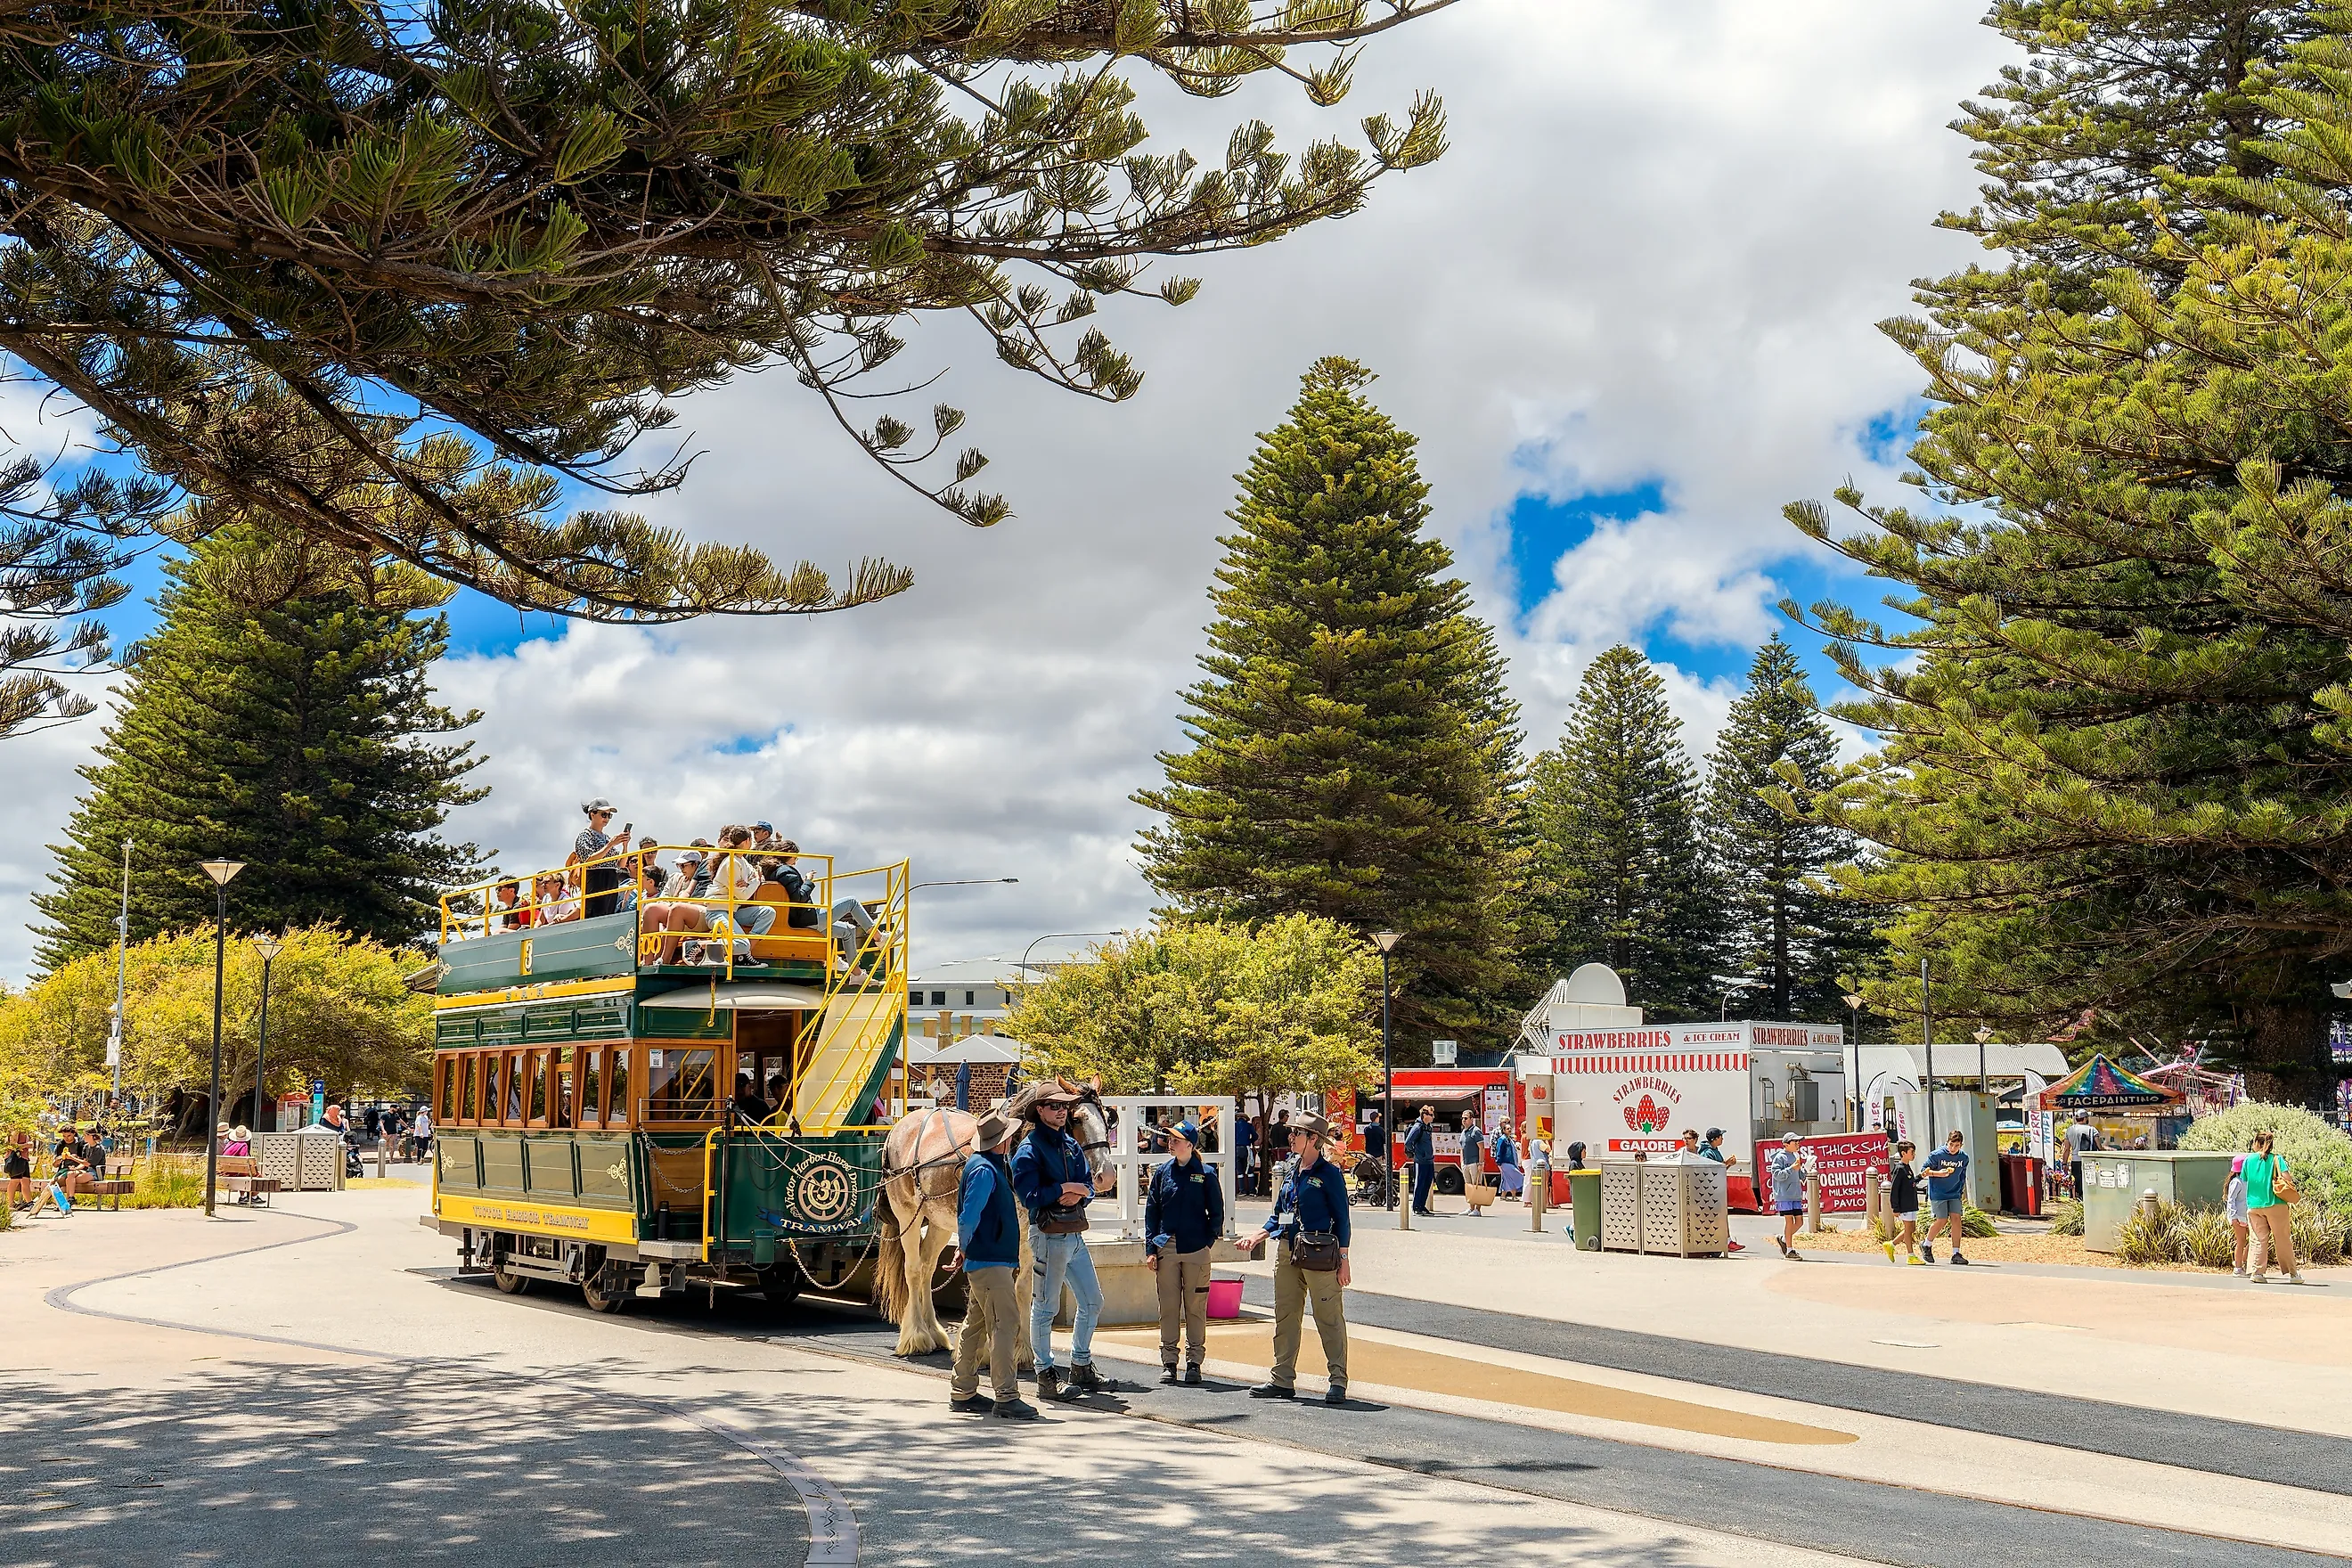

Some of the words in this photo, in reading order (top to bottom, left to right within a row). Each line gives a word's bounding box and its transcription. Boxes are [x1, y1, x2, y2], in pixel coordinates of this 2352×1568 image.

[525, 941, 533, 971] 3
[1558, 1030, 1671, 1050] STRAWBERRIES
[1683, 1033, 1691, 1042] &
[1694, 1033, 1707, 1042] ICE
[1710, 1032, 1740, 1041] CREAM
[1752, 1026, 1809, 1047] STRAWBERRIES
[1817, 1033, 1825, 1043] ICE
[1825, 1033, 1841, 1044] CREAM
[1613, 1075, 1682, 1105] STRAWBERRIES
[1620, 1140, 1675, 1151] GALORE
[784, 1175, 796, 1209] Victor
[793, 1152, 827, 1179] Harbor
[827, 1150, 852, 1172] Horse
[848, 1172, 858, 1207] Drawn
[817, 1179, 830, 1201] 3
[1817, 1172, 1864, 1188] OGHURT
[473, 1205, 502, 1220] VICTOR
[506, 1209, 540, 1224] HARBOR
[543, 1213, 589, 1229] TRAMWAY
[780, 1215, 863, 1233] TRAMWAY
